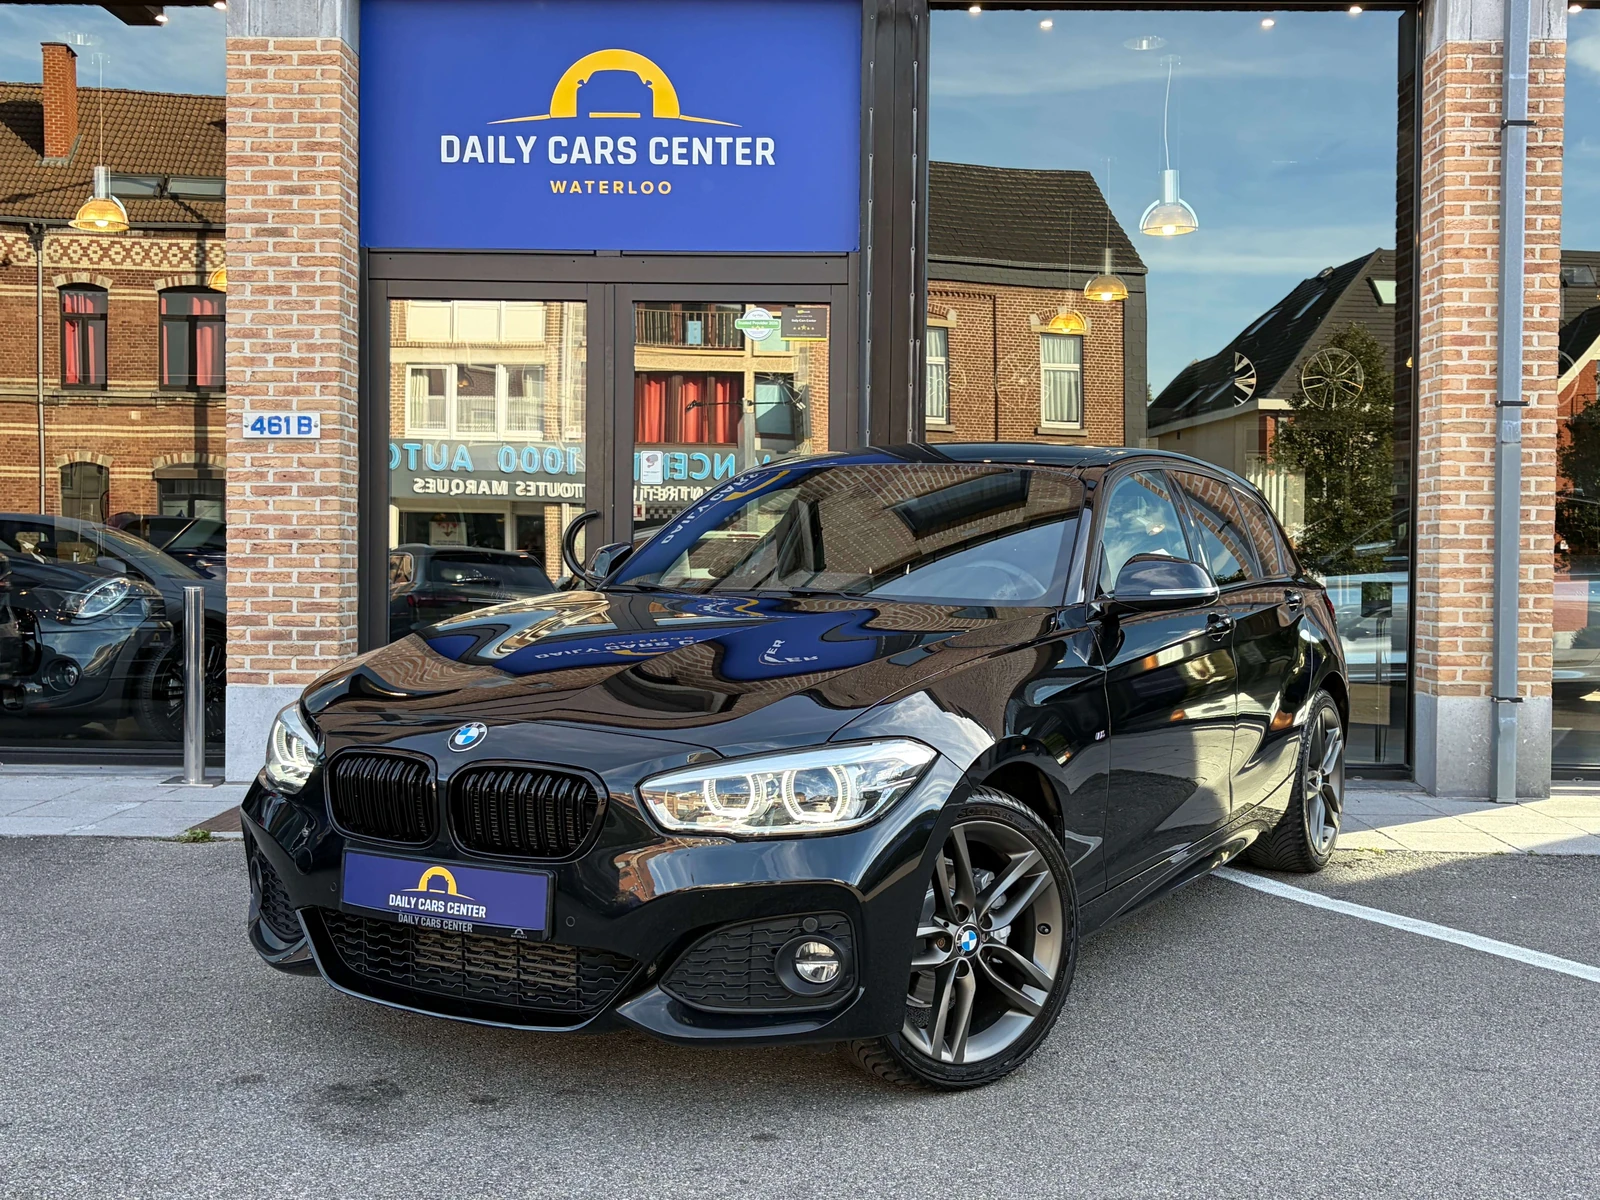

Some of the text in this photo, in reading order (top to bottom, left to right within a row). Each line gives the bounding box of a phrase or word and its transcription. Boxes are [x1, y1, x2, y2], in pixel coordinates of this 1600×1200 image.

[440, 134, 776, 166] DAILY CARS CENTER
[550, 180, 672, 195] WATERLOO
[250, 416, 312, 435] 461 B
[389, 893, 486, 918] DAILY CARS CENTER
[398, 913, 473, 933] DAILY CARS CENTER
